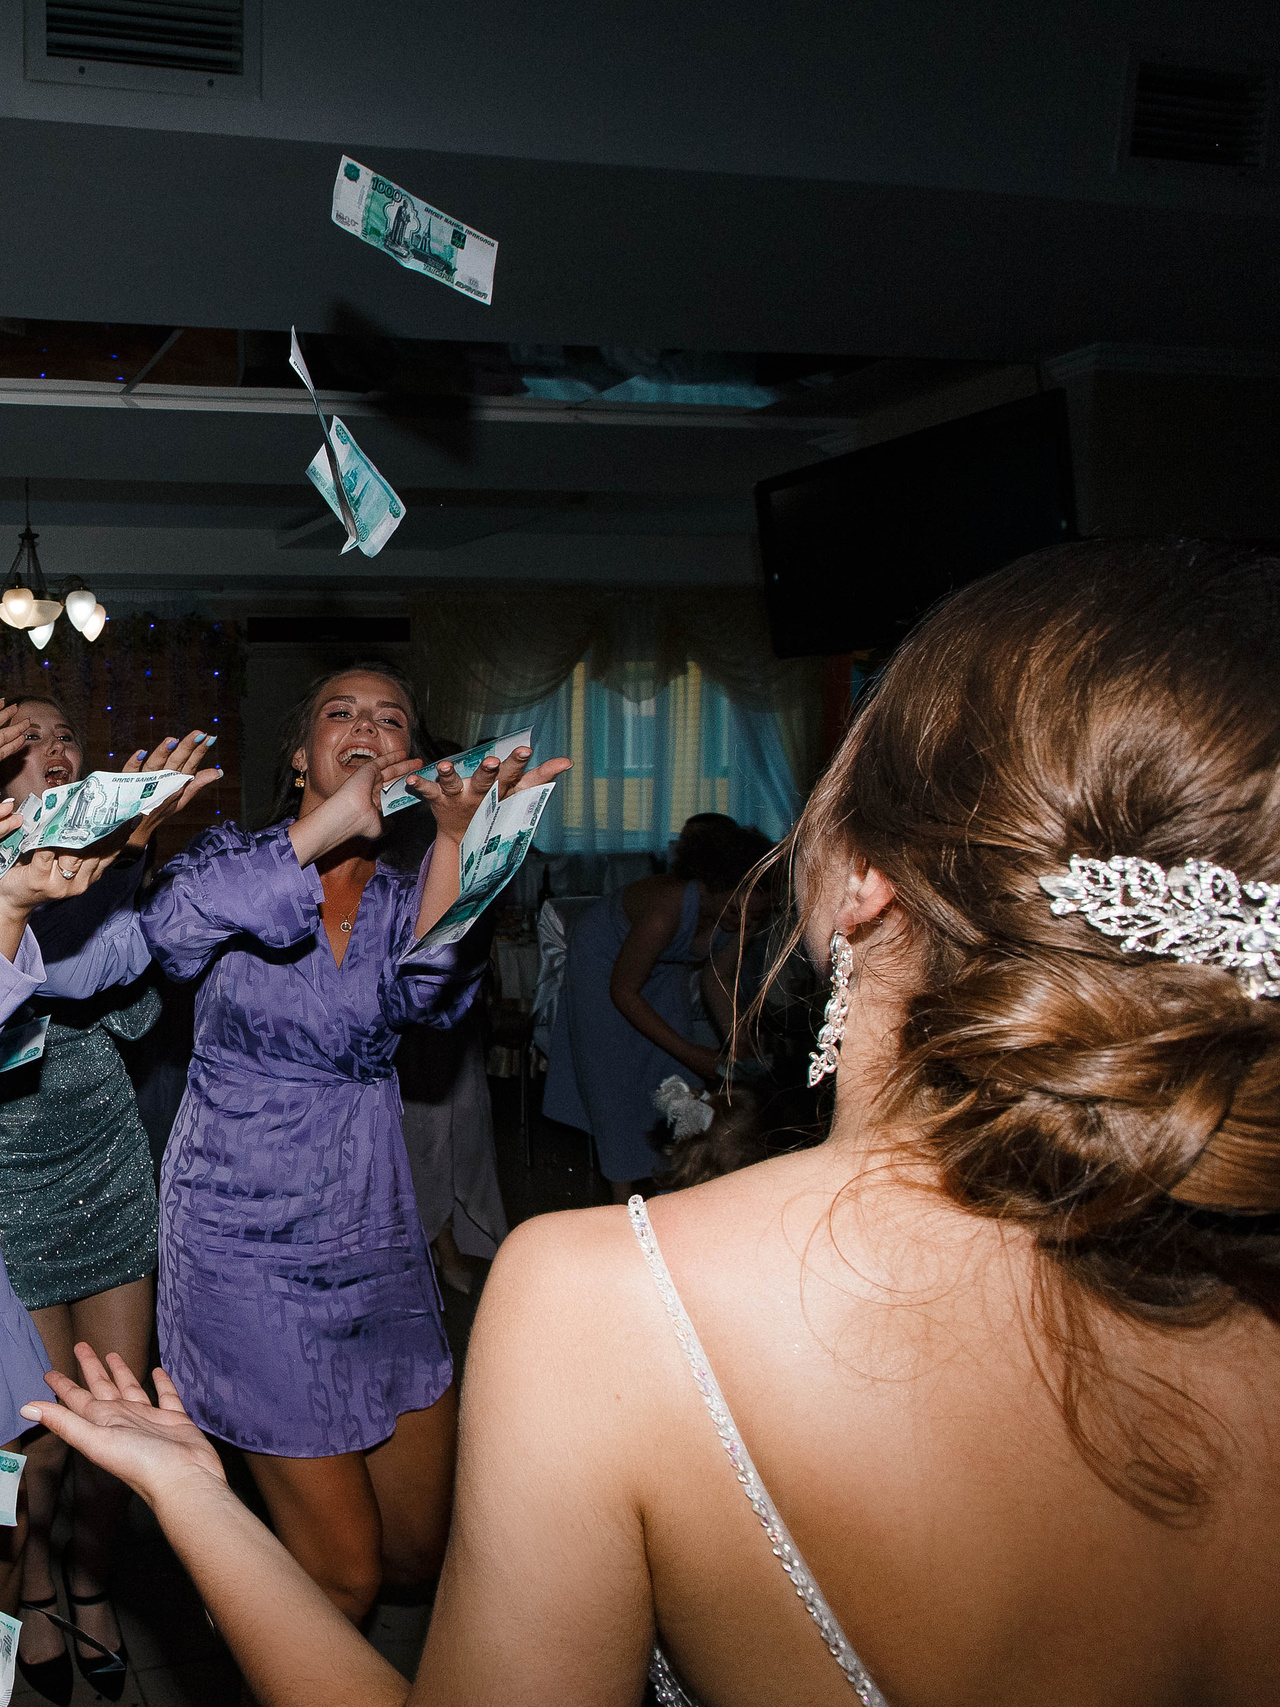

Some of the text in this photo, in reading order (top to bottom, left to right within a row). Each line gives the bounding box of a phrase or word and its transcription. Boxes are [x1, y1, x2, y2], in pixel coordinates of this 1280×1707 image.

[371, 176, 403, 203] 1000
[444, 217, 464, 232] БАНКА
[465, 228, 495, 248] ПРИКОЛОВ
